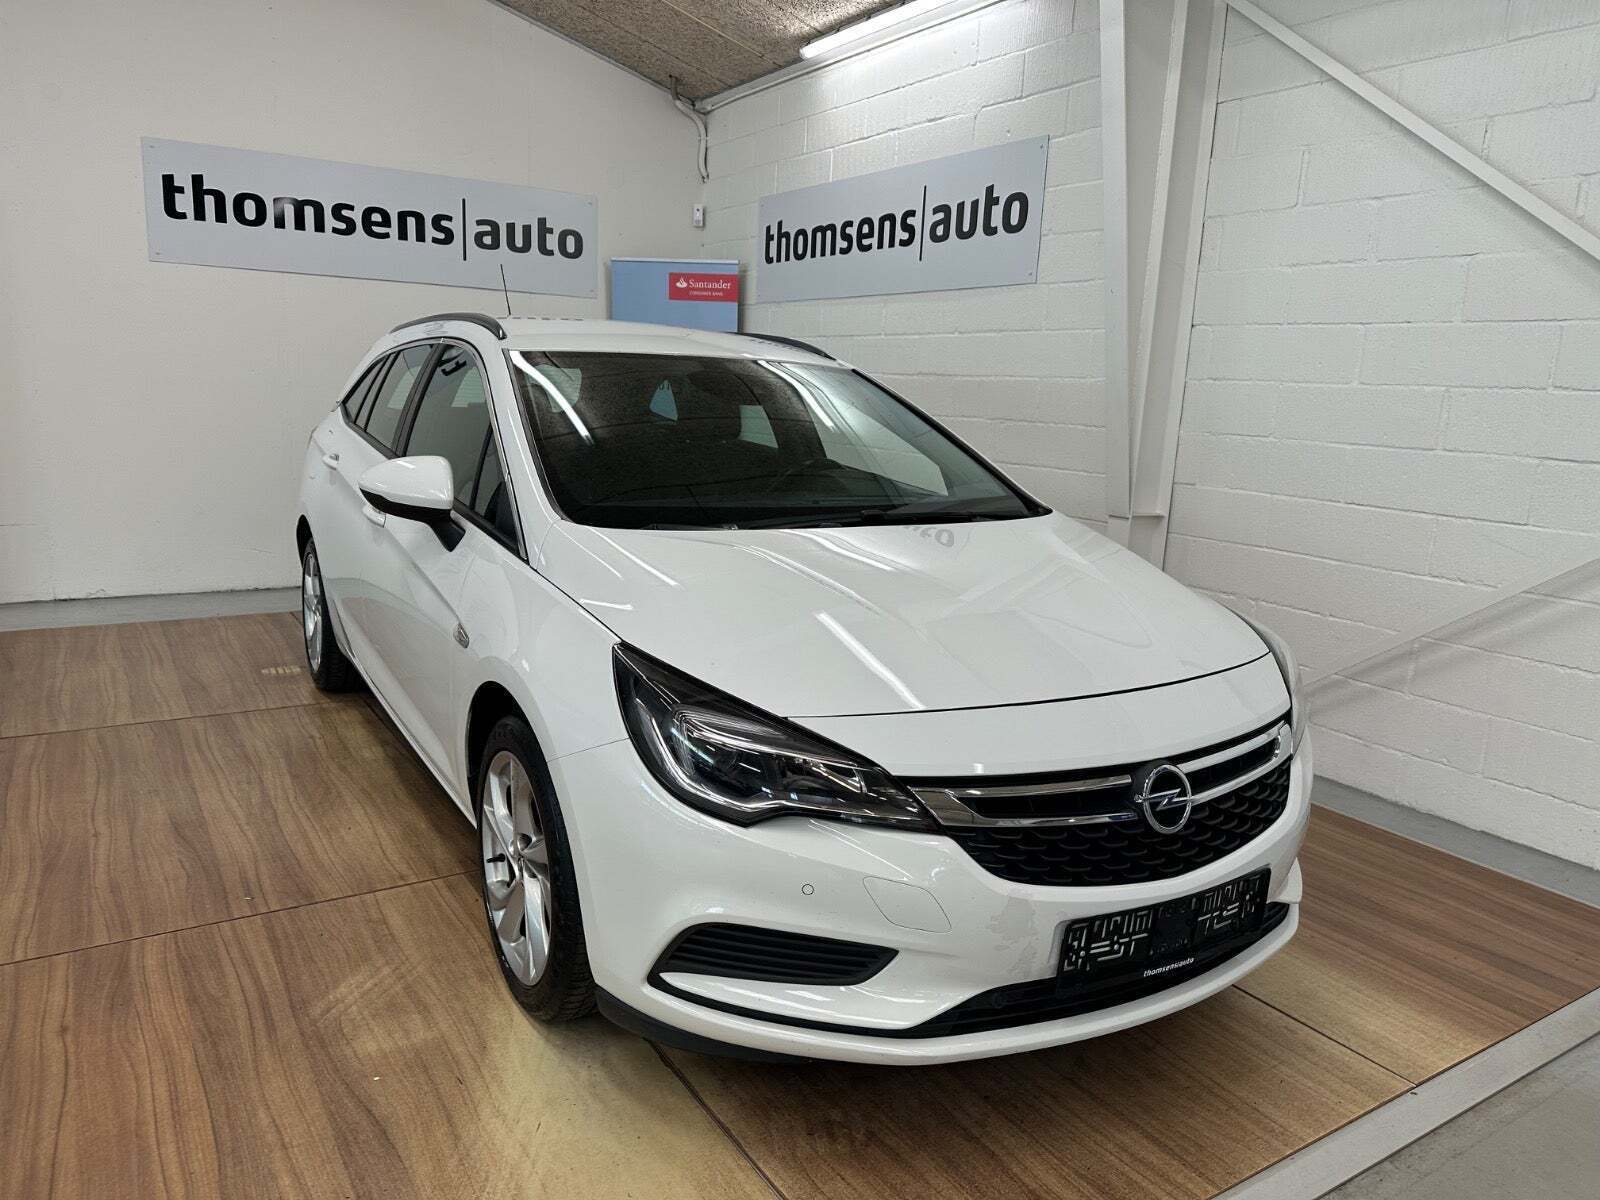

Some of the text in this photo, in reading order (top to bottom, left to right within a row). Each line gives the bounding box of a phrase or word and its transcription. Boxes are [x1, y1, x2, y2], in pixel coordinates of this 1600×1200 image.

[161, 173, 584, 260] thomsens auto
[764, 183, 1029, 265] thomsens auto
[689, 278, 731, 289] Santander
